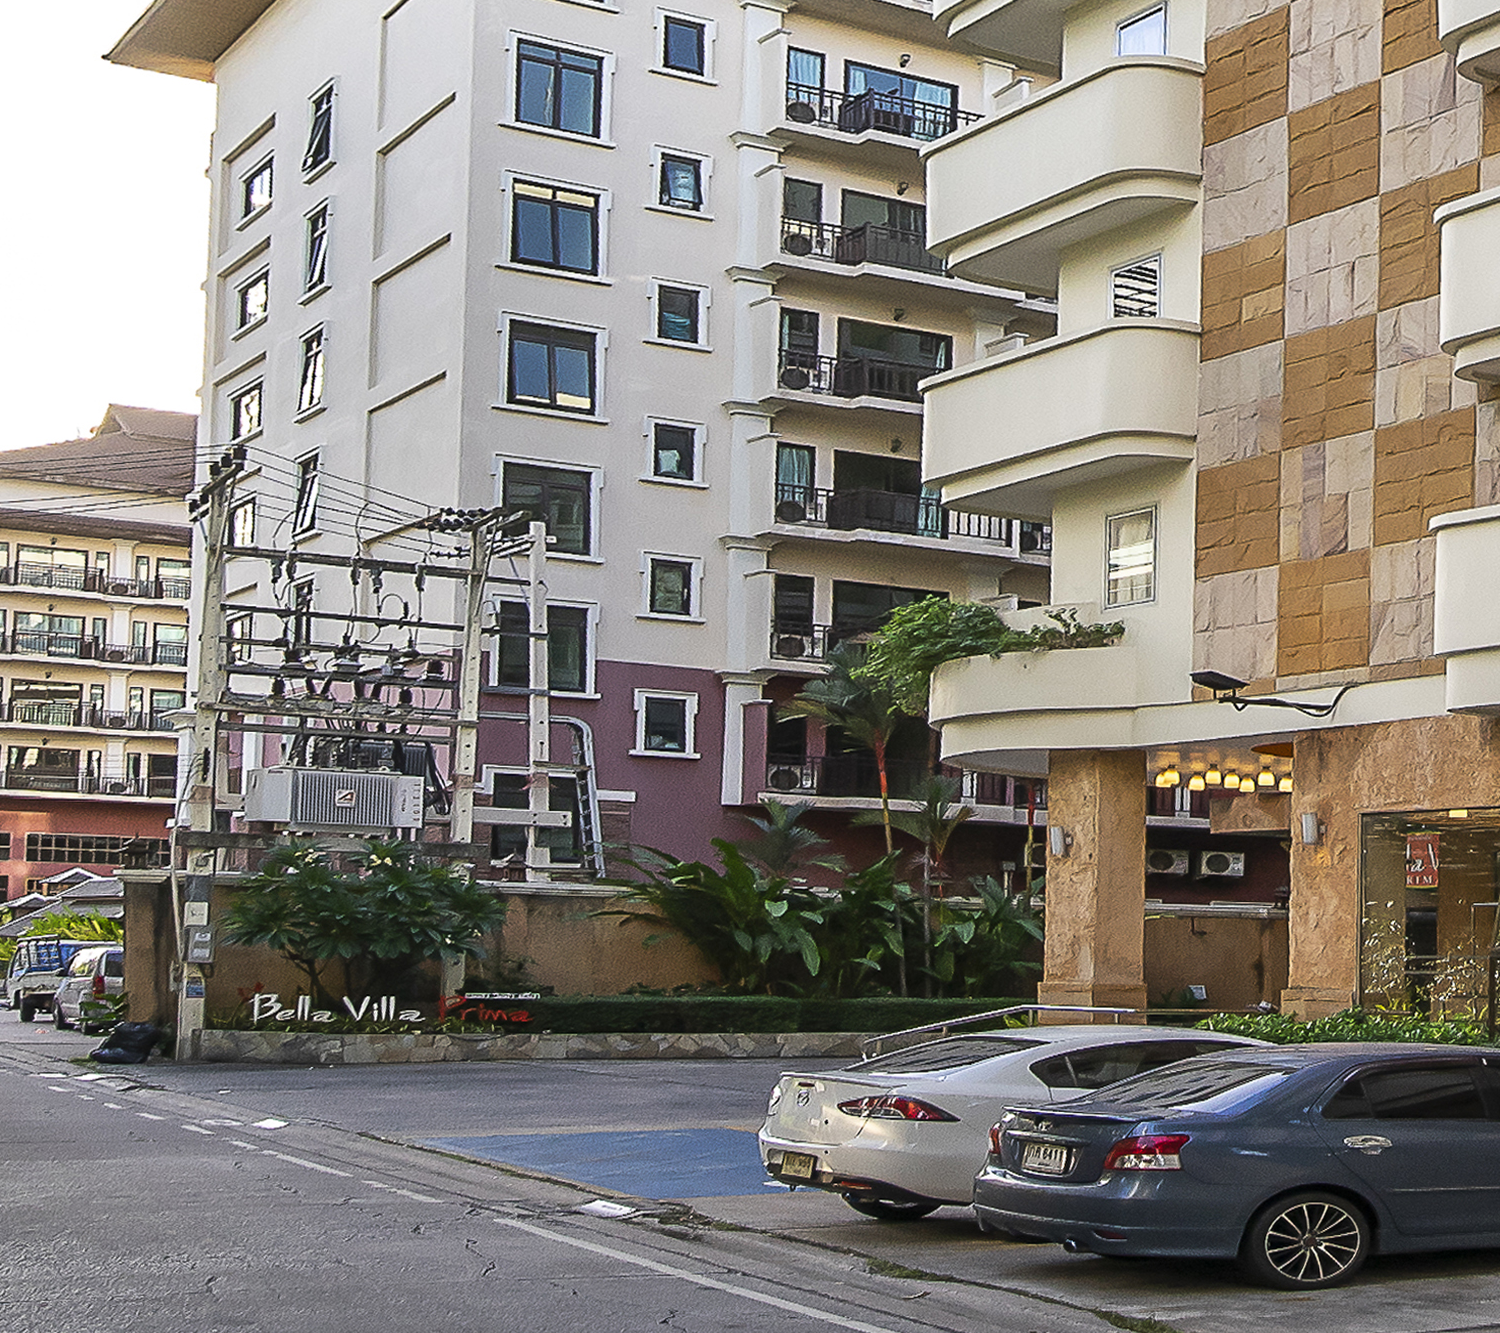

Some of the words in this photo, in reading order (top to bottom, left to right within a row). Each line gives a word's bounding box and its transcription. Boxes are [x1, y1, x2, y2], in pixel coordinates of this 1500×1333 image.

[250, 993, 336, 1025] Bella
[343, 995, 426, 1023] Villa
[438, 994, 534, 1025] Prima
